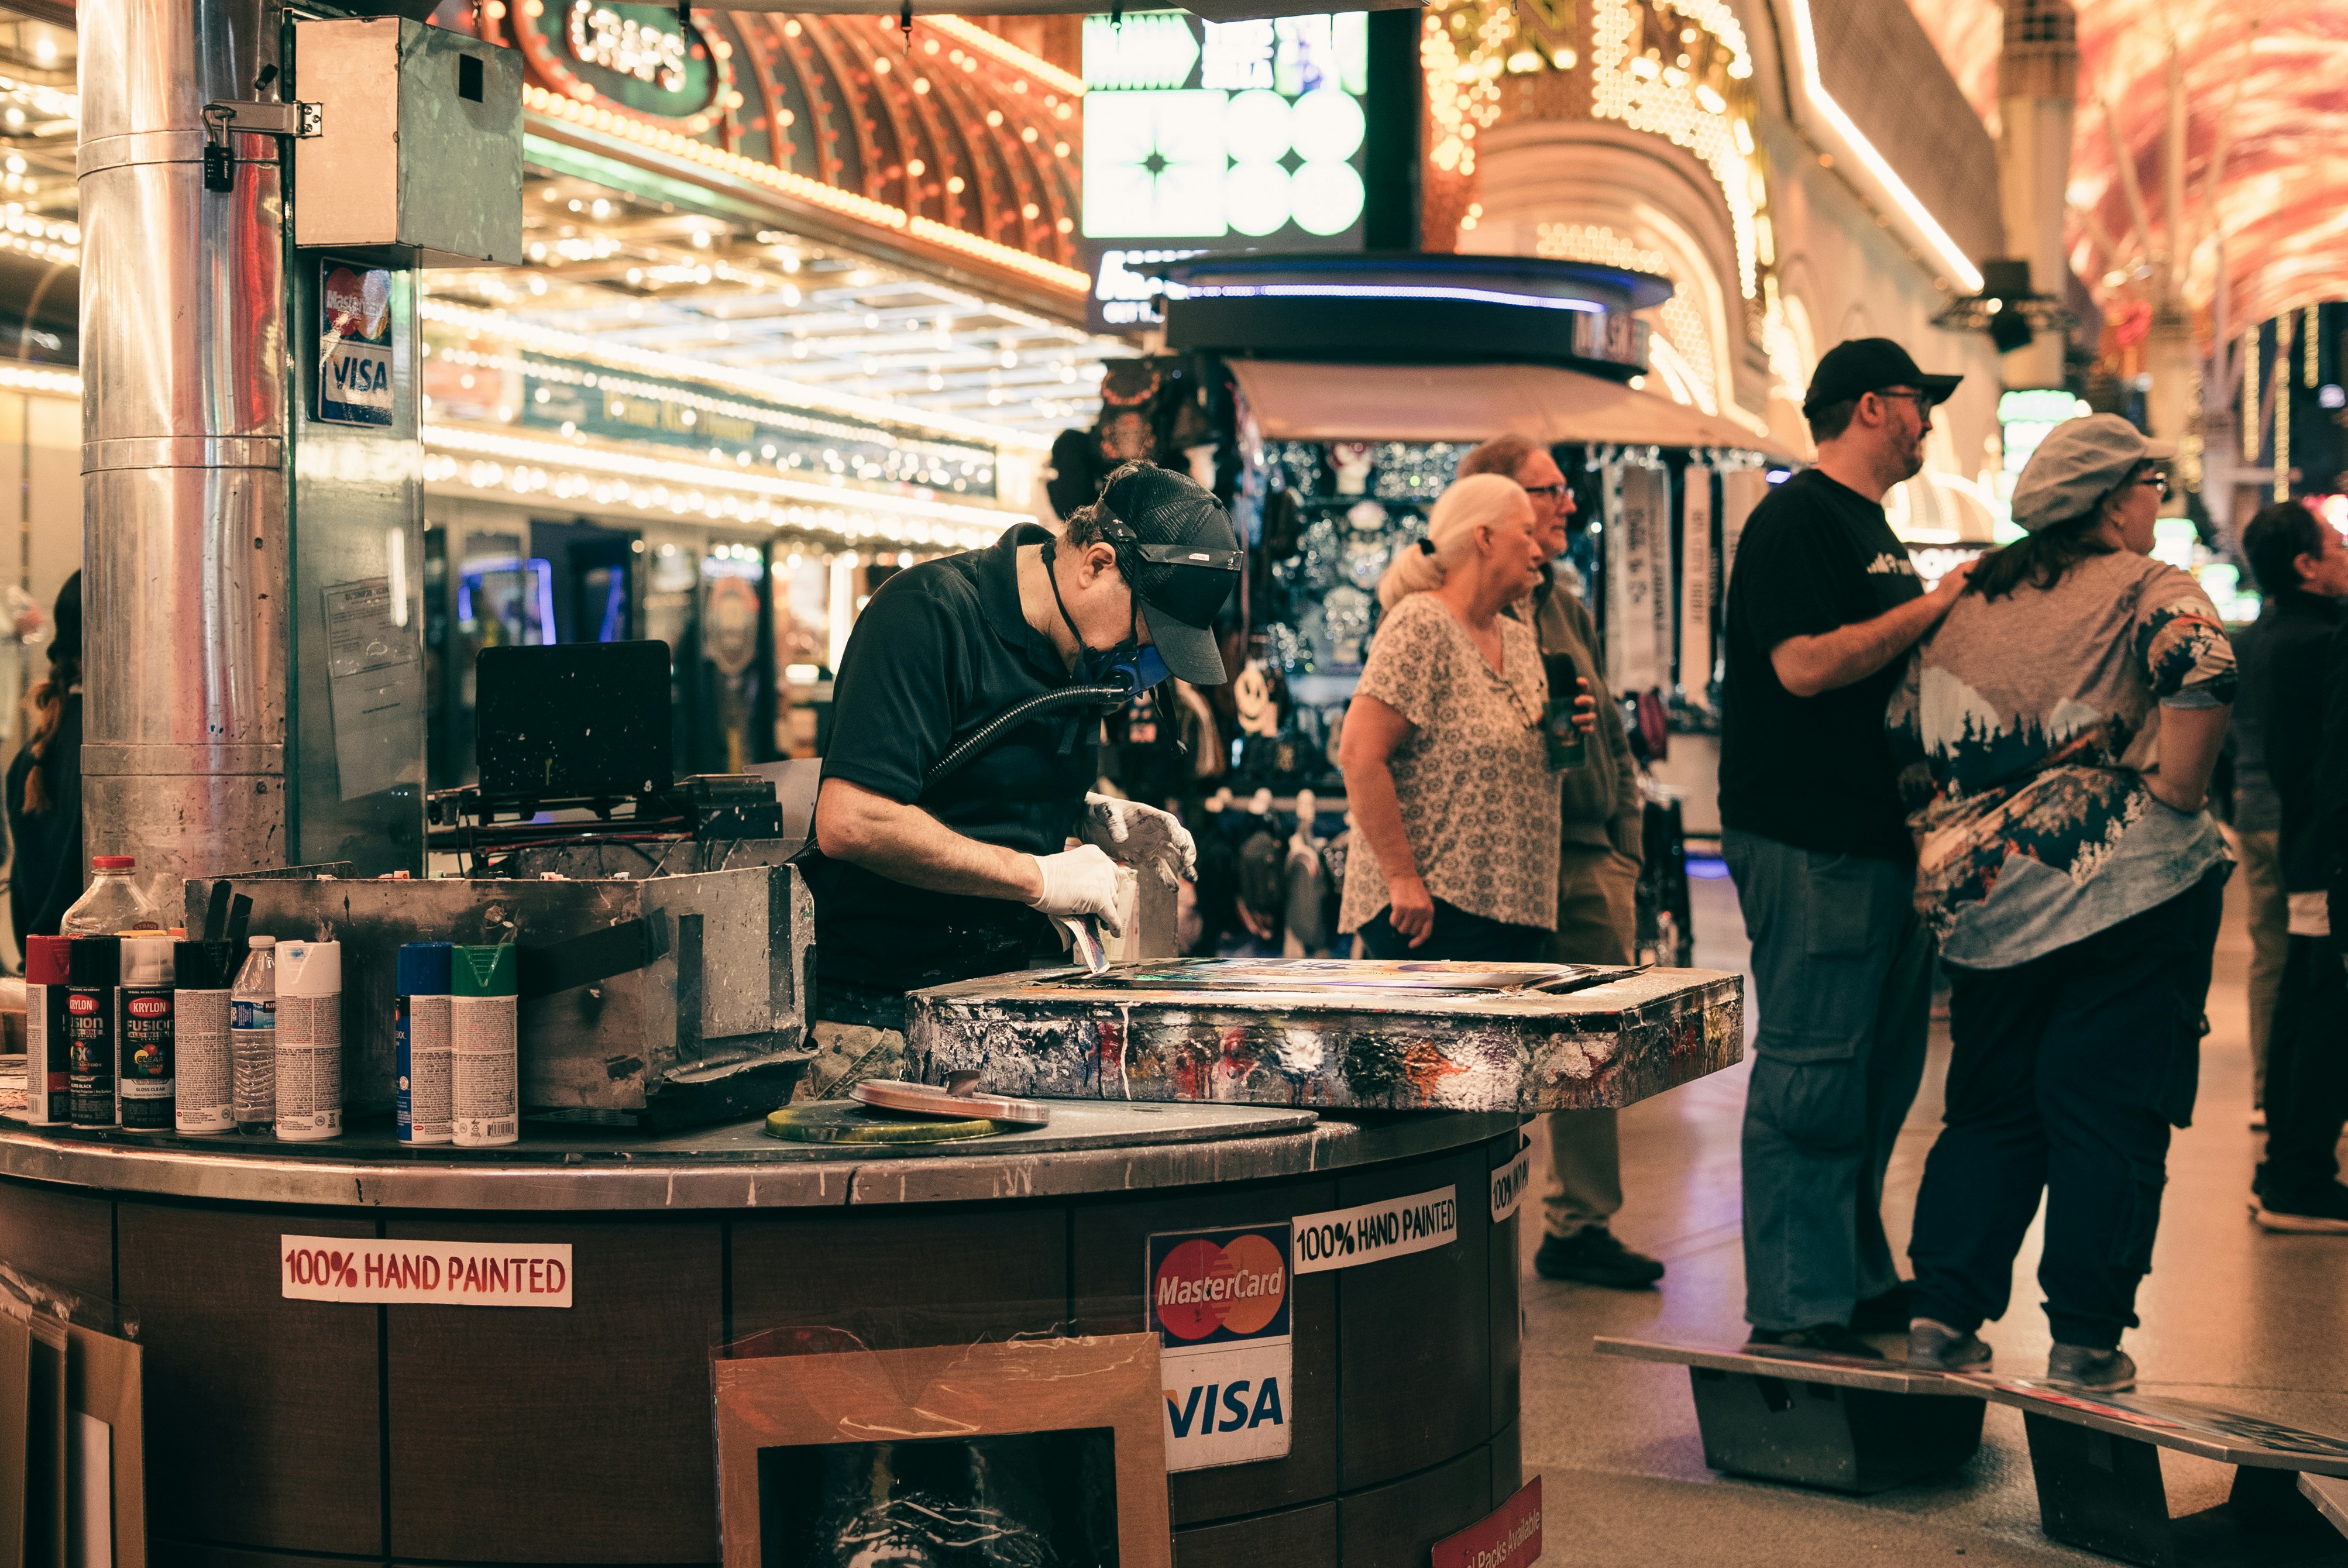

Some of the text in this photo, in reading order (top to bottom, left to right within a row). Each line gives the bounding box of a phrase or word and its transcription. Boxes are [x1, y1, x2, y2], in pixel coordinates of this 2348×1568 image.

[332, 356, 387, 392] VISA
[133, 1002, 166, 1013] KRYLON
[1297, 1199, 1455, 1261] 100% HAND PAINTED
[286, 1249, 566, 1294] 100% HAND PAINTED
[1157, 1266, 1283, 1306] MasterCard
[1163, 1377, 1284, 1439] VISA
[1478, 1508, 1541, 1568] Packs Available
